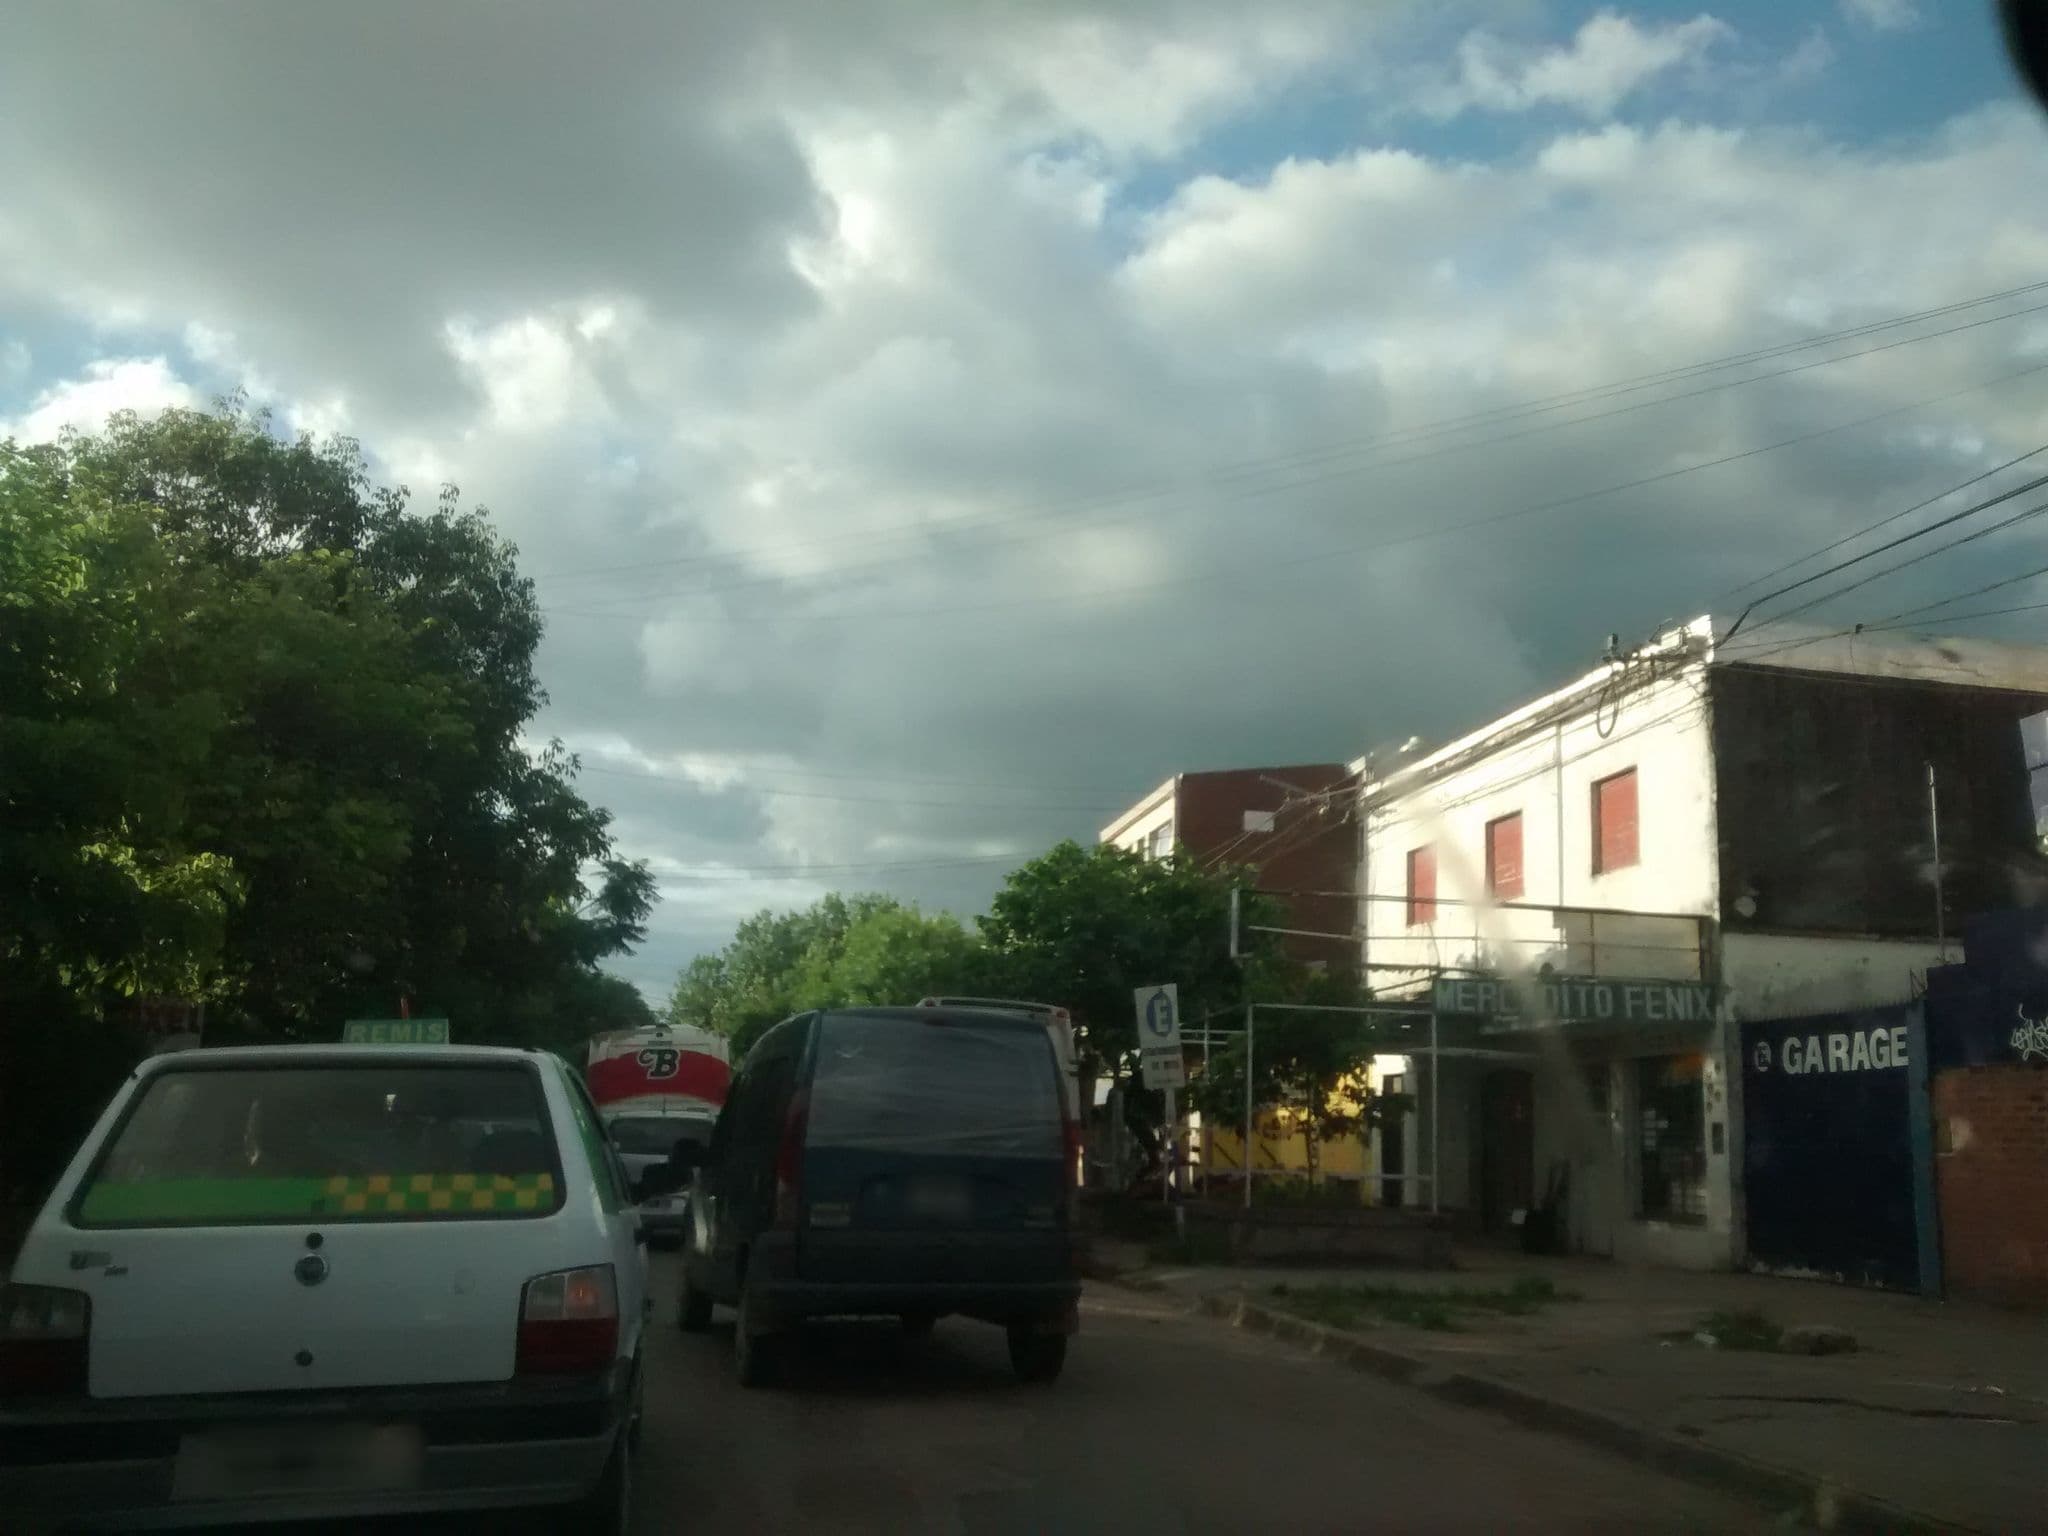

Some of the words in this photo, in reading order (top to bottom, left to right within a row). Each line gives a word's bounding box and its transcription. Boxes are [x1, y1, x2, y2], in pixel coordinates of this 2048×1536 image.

[1435, 981, 1614, 1018] MERCDITO
[1624, 985, 1712, 1021] FENIX
[350, 1022, 444, 1044] REMIS
[1782, 1026, 1909, 1074] GARAGE
